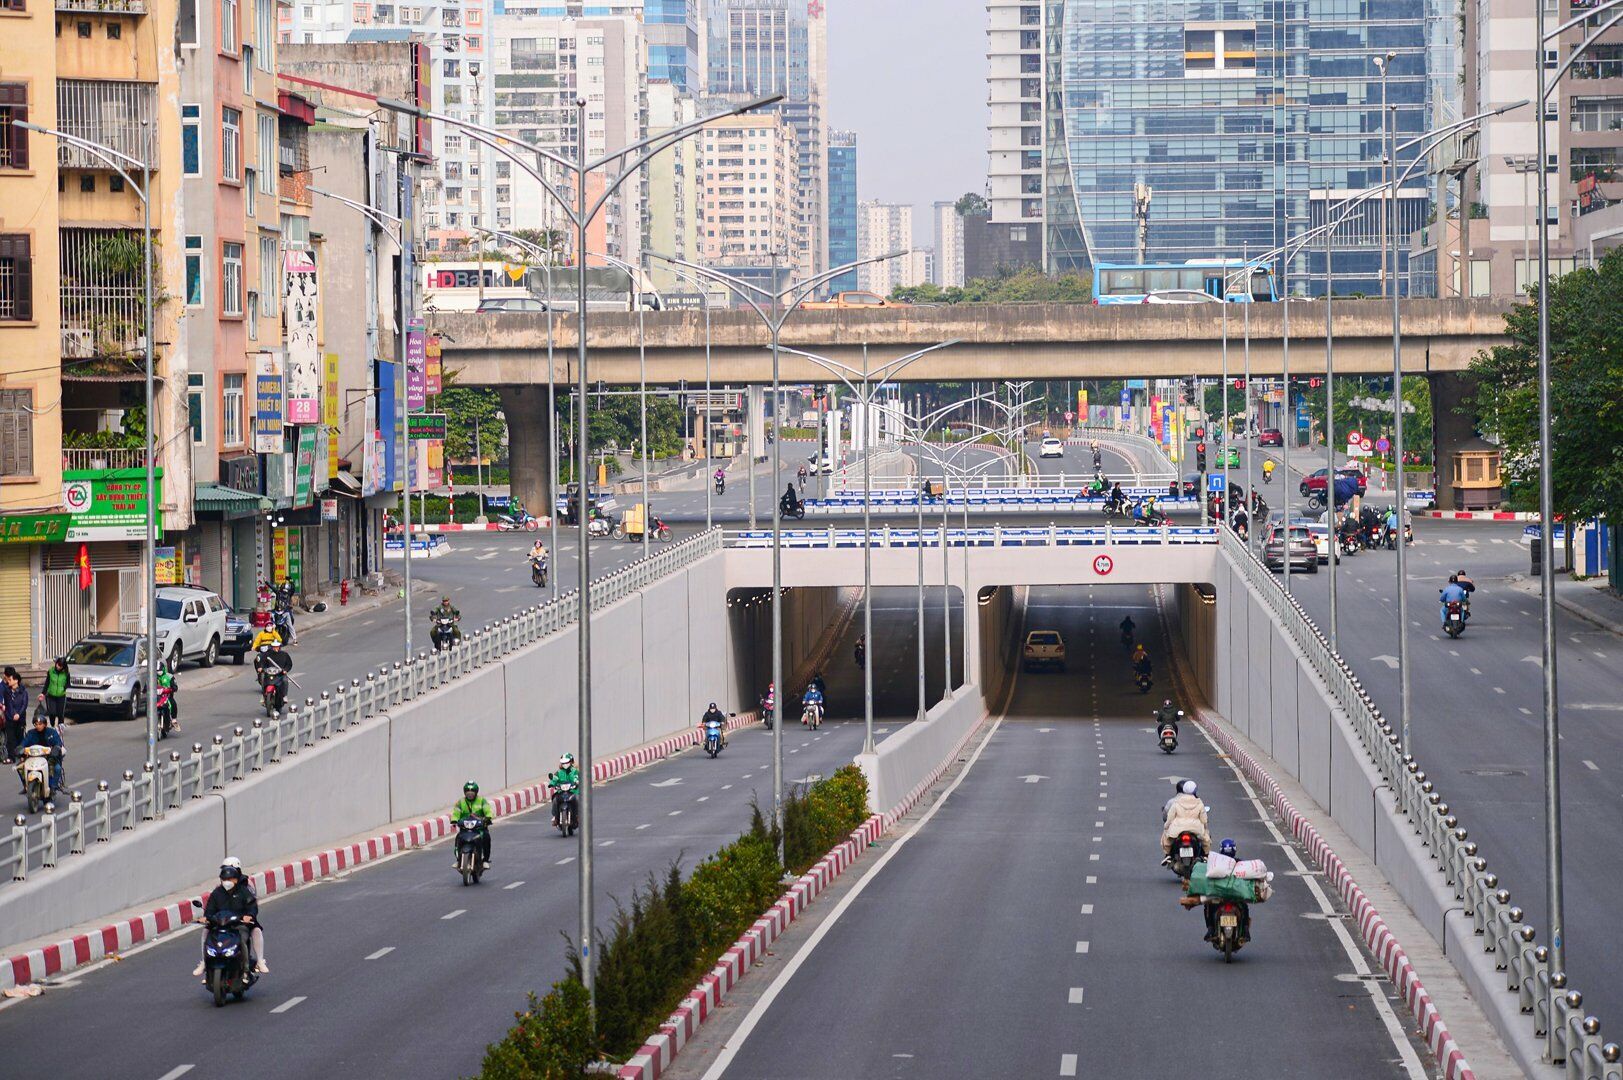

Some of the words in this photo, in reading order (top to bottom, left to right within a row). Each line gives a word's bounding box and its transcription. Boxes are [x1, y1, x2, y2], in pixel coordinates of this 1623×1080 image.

[427, 271, 503, 288] HDBank
[258, 381, 281, 393] CAMERA
[1235, 381, 1245, 389] 01
[1310, 379, 1320, 388] 01
[257, 396, 275, 411] THIẾT
[296, 401, 310, 412] 28
[258, 419, 266, 431] AN
[267, 419, 281, 431] NINH
